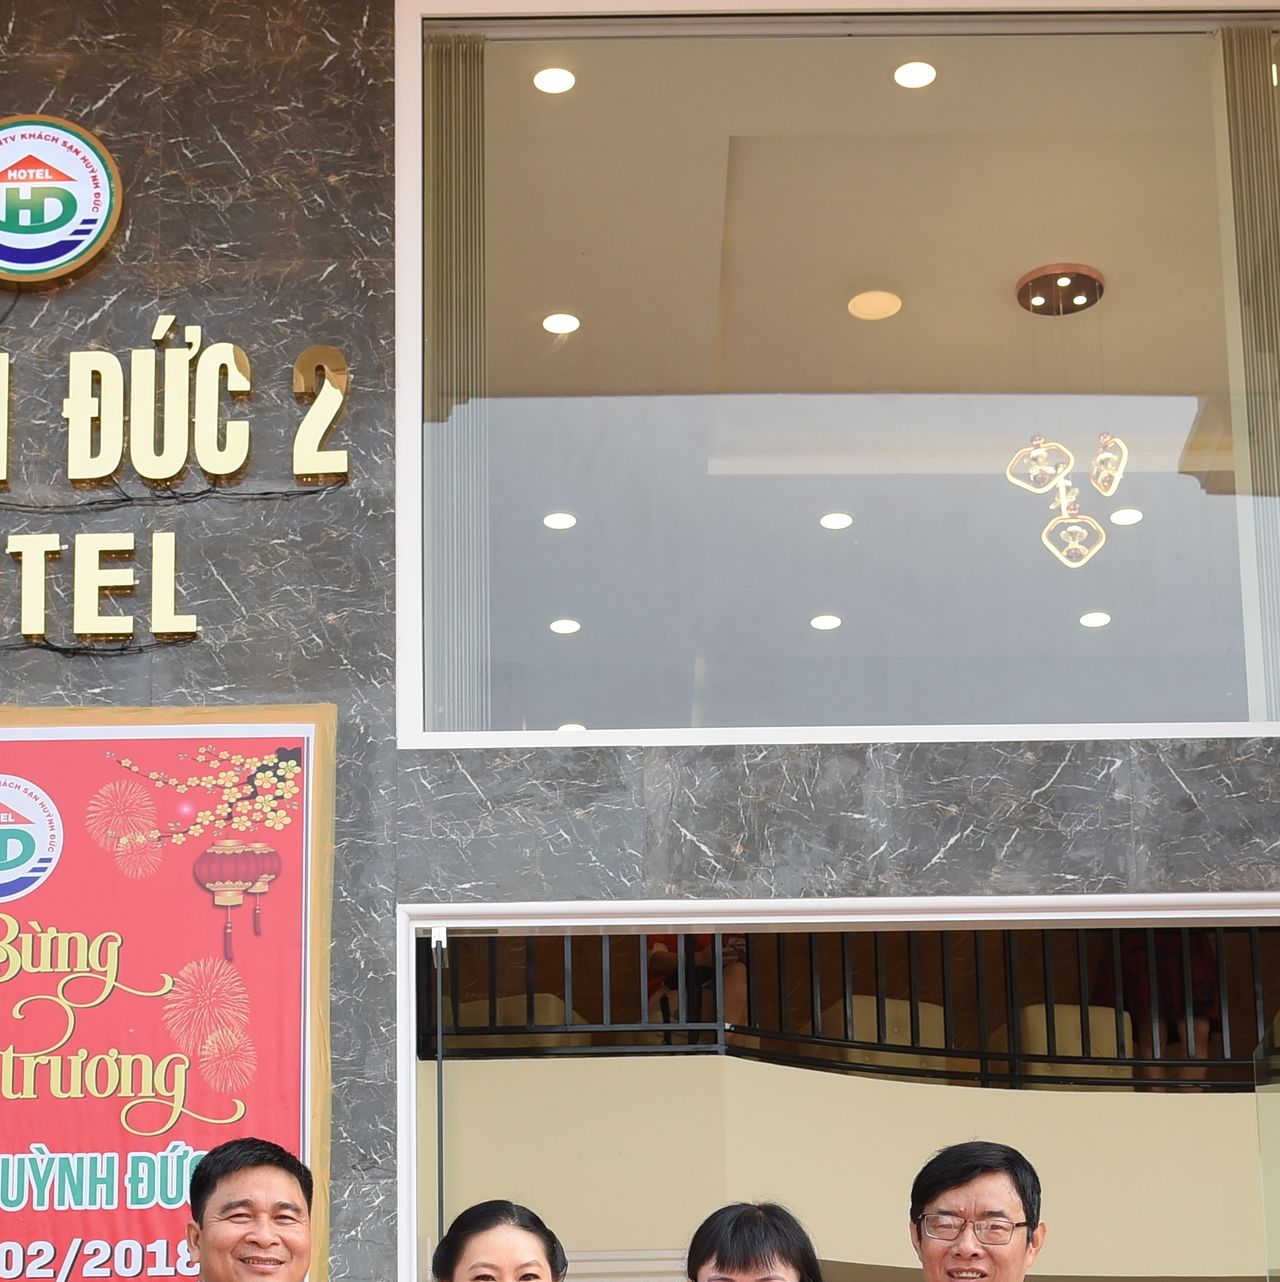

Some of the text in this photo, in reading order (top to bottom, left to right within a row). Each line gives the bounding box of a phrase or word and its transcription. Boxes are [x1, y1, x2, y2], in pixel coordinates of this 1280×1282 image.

[7, 168, 54, 181] HOTEL
[20, 131, 60, 144] KHÁCH
[60, 140, 82, 157] SẠN
[80, 156, 102, 190] HUỲNH
[91, 192, 103, 214] ĐỨC
[62, 314, 253, 486] ĐỨC
[292, 344, 352, 482] 2
[22, 787, 40, 801] SẠN
[47, 833, 57, 853] ĐỨC
[1, 1045, 246, 1136] trương
[124, 1141, 209, 1210] ĐỨ
